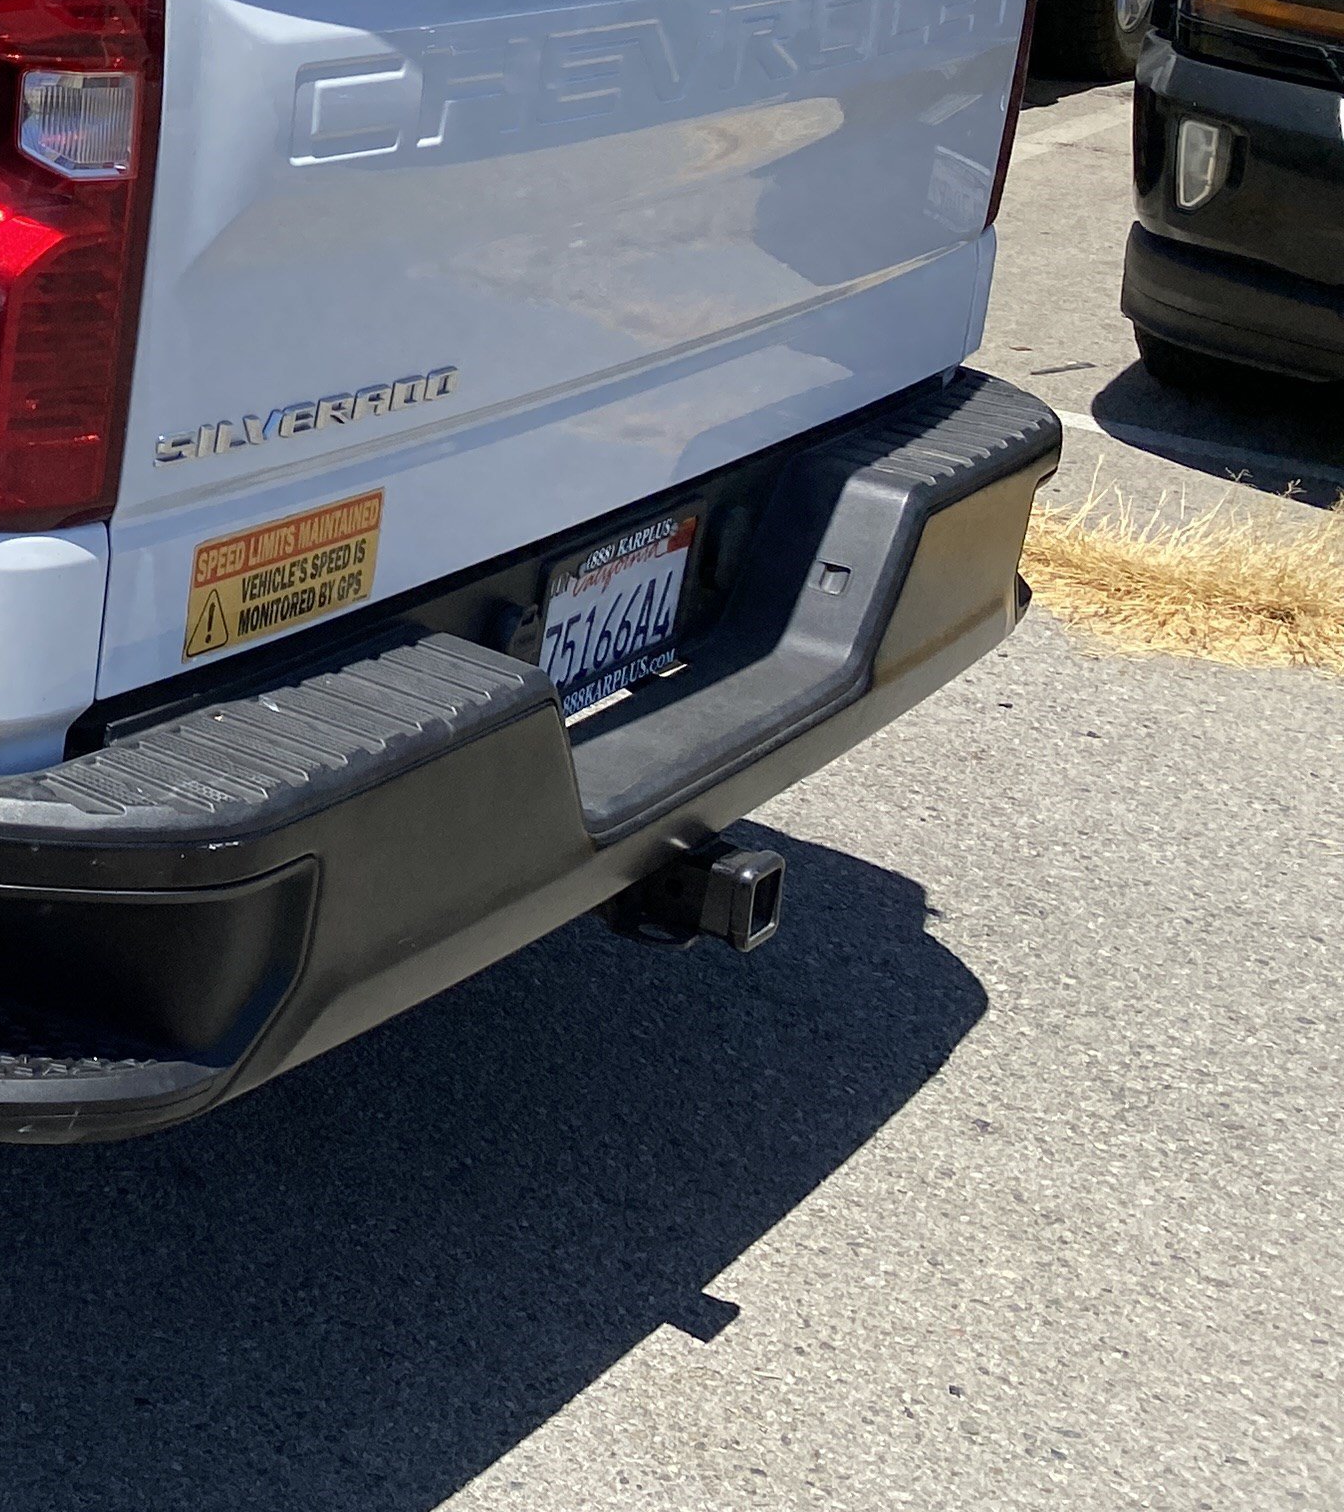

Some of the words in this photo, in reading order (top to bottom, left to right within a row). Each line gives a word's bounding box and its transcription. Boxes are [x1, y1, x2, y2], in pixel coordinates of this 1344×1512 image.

[153, 365, 458, 468] SILVERADO
[196, 541, 247, 582] SPEED
[249, 525, 296, 566] LIMITS
[298, 497, 380, 550] MAINTAINED
[242, 557, 308, 603] VEHICLE'S
[310, 543, 351, 580] SPEED
[352, 538, 367, 565] IS
[585, 545, 615, 570] (888)
[616, 518, 673, 557] KARPLUS
[237, 586, 315, 637] MONITORED
[317, 579, 336, 608] BY
[337, 569, 362, 601] GPS
[546, 570, 673, 688] 75166A4
